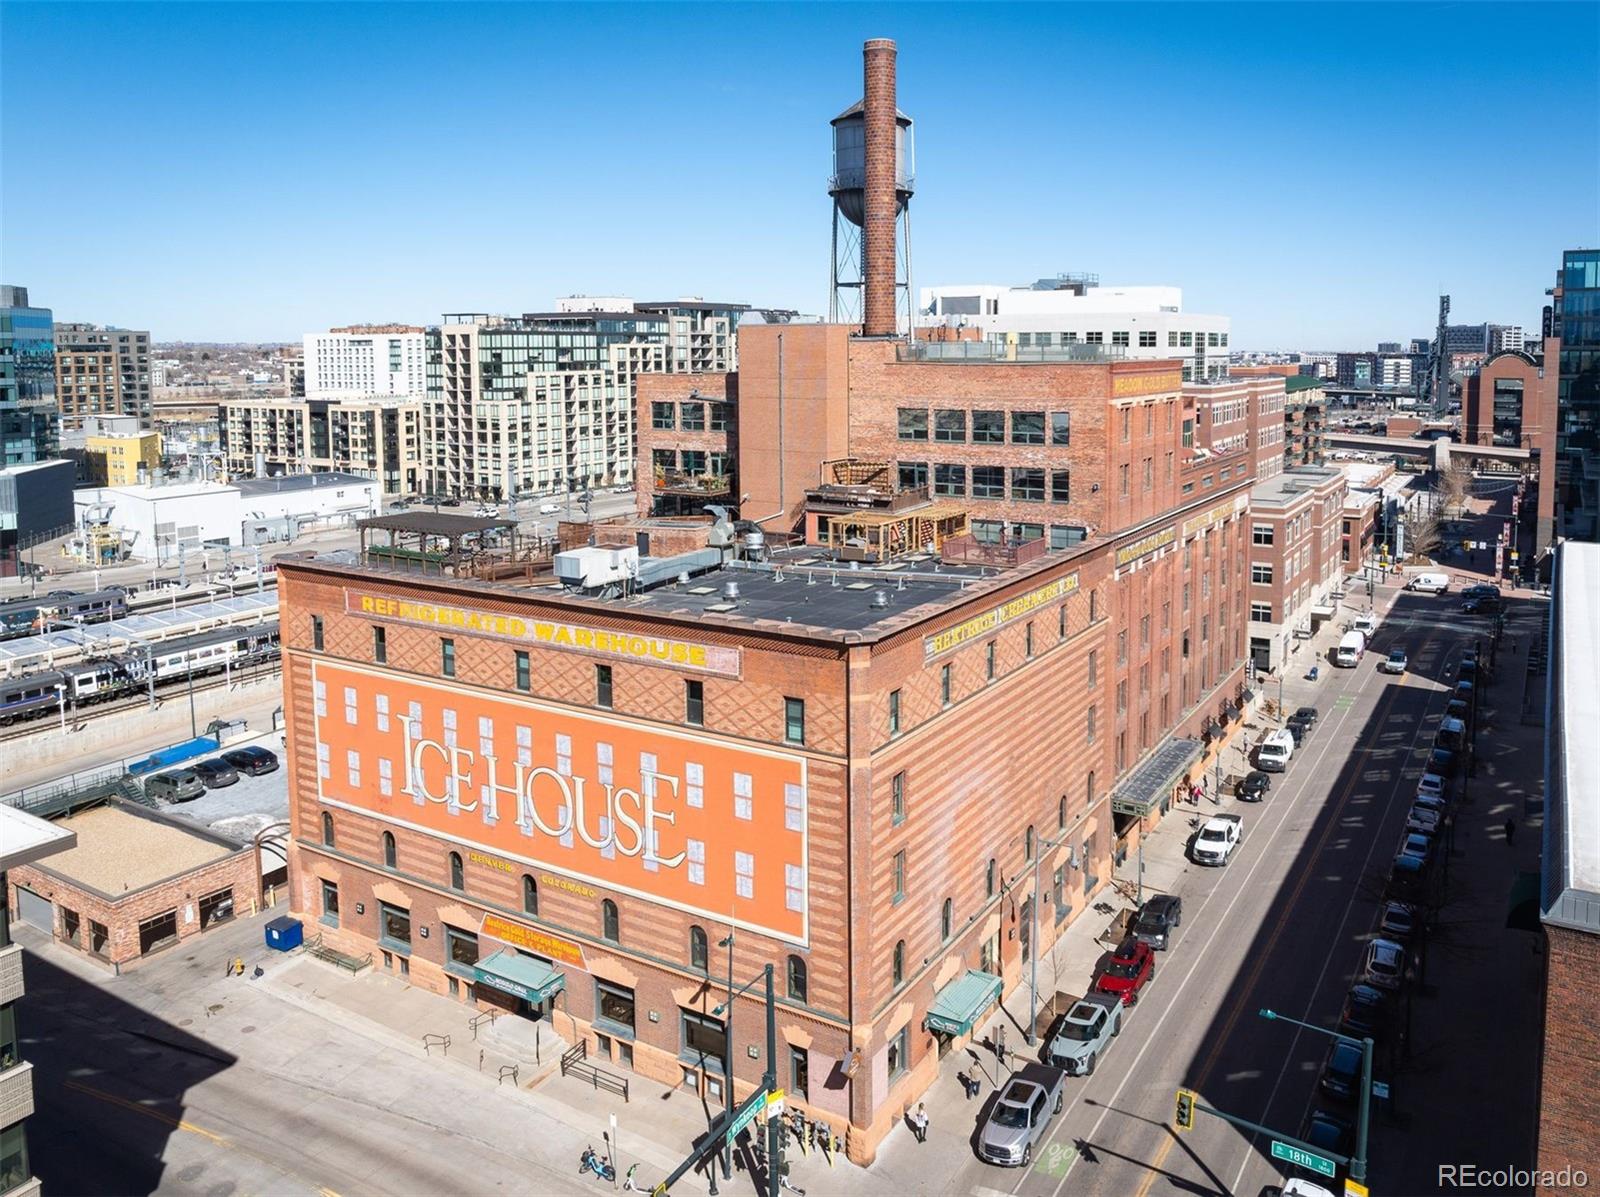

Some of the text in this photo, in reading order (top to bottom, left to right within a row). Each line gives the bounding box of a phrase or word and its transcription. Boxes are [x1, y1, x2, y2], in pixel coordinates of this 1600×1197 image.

[362, 596, 707, 667] REFRIGERATED WAREHOUSE
[469, 851, 597, 898] DENVER COLORADO
[1288, 1149, 1312, 1166] 18th
